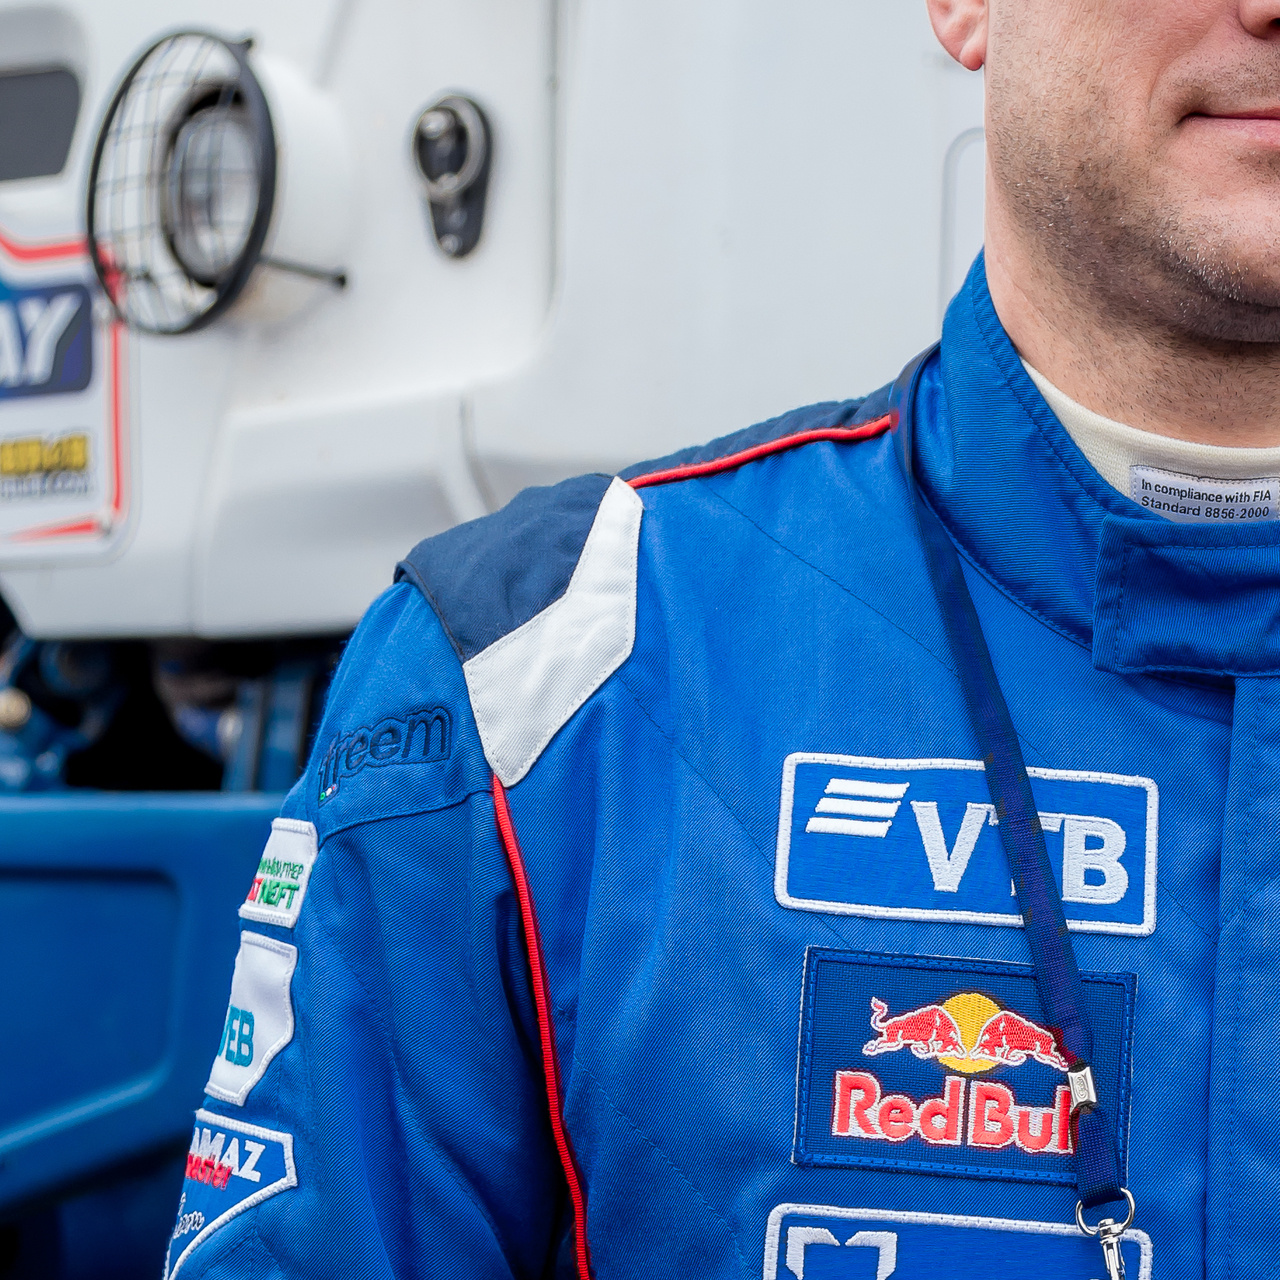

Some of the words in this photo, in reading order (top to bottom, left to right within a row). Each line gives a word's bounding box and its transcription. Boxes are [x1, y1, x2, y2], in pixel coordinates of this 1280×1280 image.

[1141, 478, 1152, 491] In
[1154, 483, 1223, 503] compliance
[1224, 489, 1251, 503] with
[1252, 489, 1271, 502] FIA
[1141, 495, 1200, 516] Standard
[1204, 506, 1270, 519] 8856-2000
[910, 799, 1129, 905] VB
[831, 1069, 964, 1145] Red
[965, 1077, 1076, 1156] Bul
